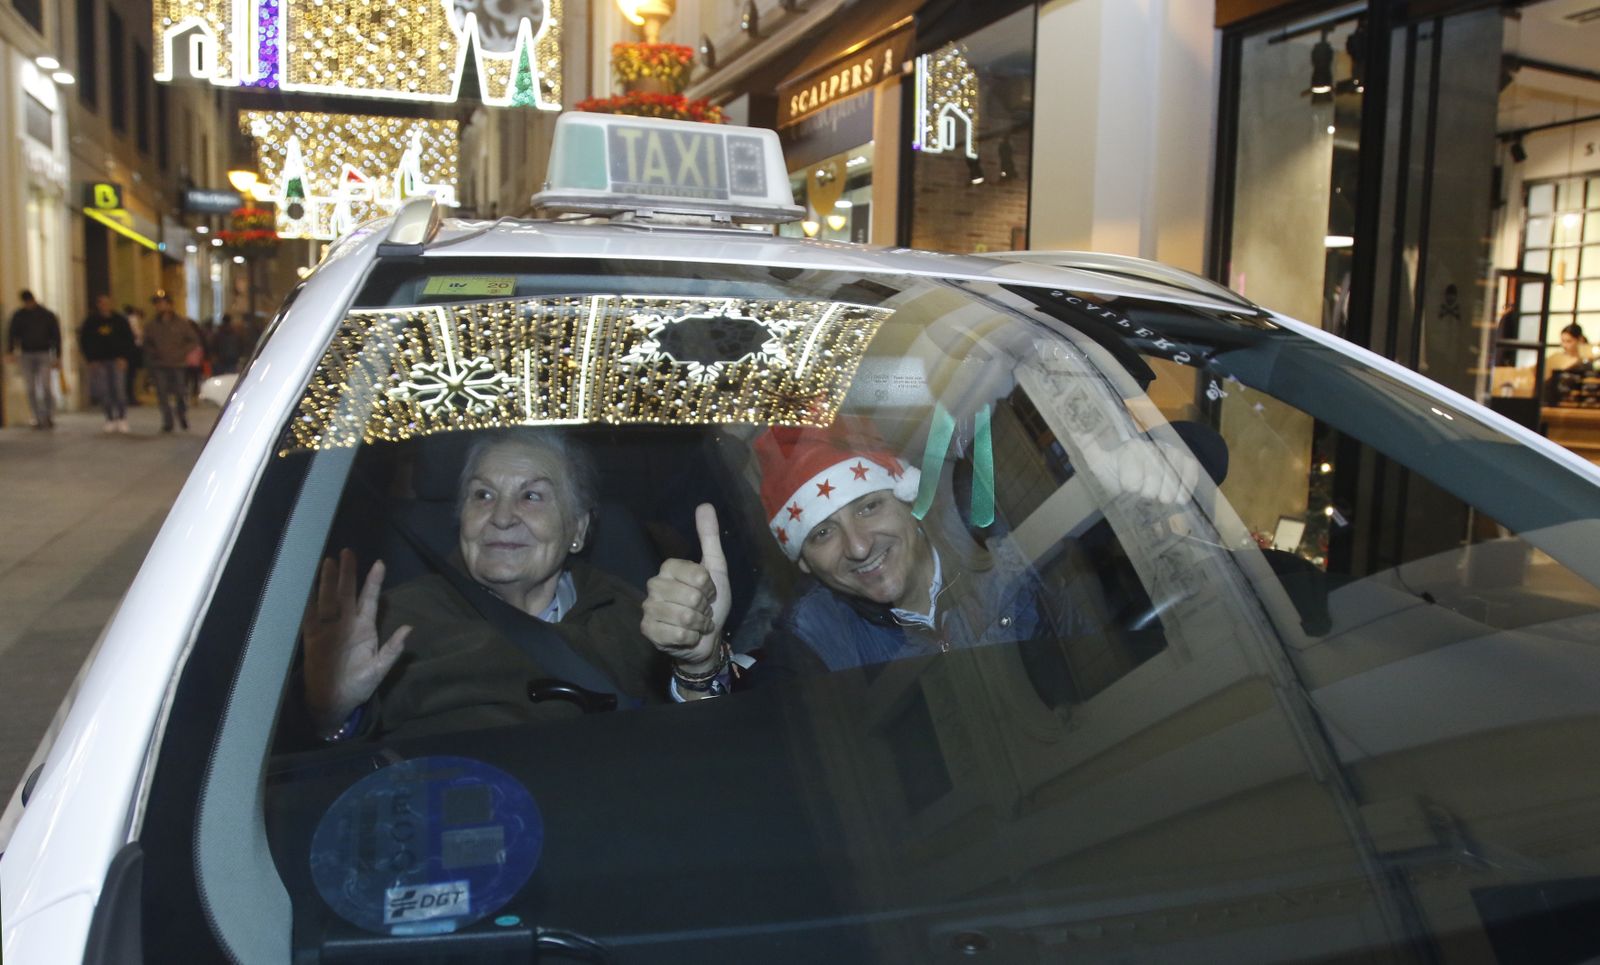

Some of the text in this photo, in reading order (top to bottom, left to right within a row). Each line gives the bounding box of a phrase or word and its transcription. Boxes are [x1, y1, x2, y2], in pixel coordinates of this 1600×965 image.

[790, 58, 873, 117] SCALPERS
[617, 127, 718, 188] TAXI
[420, 890, 465, 909] DGT
